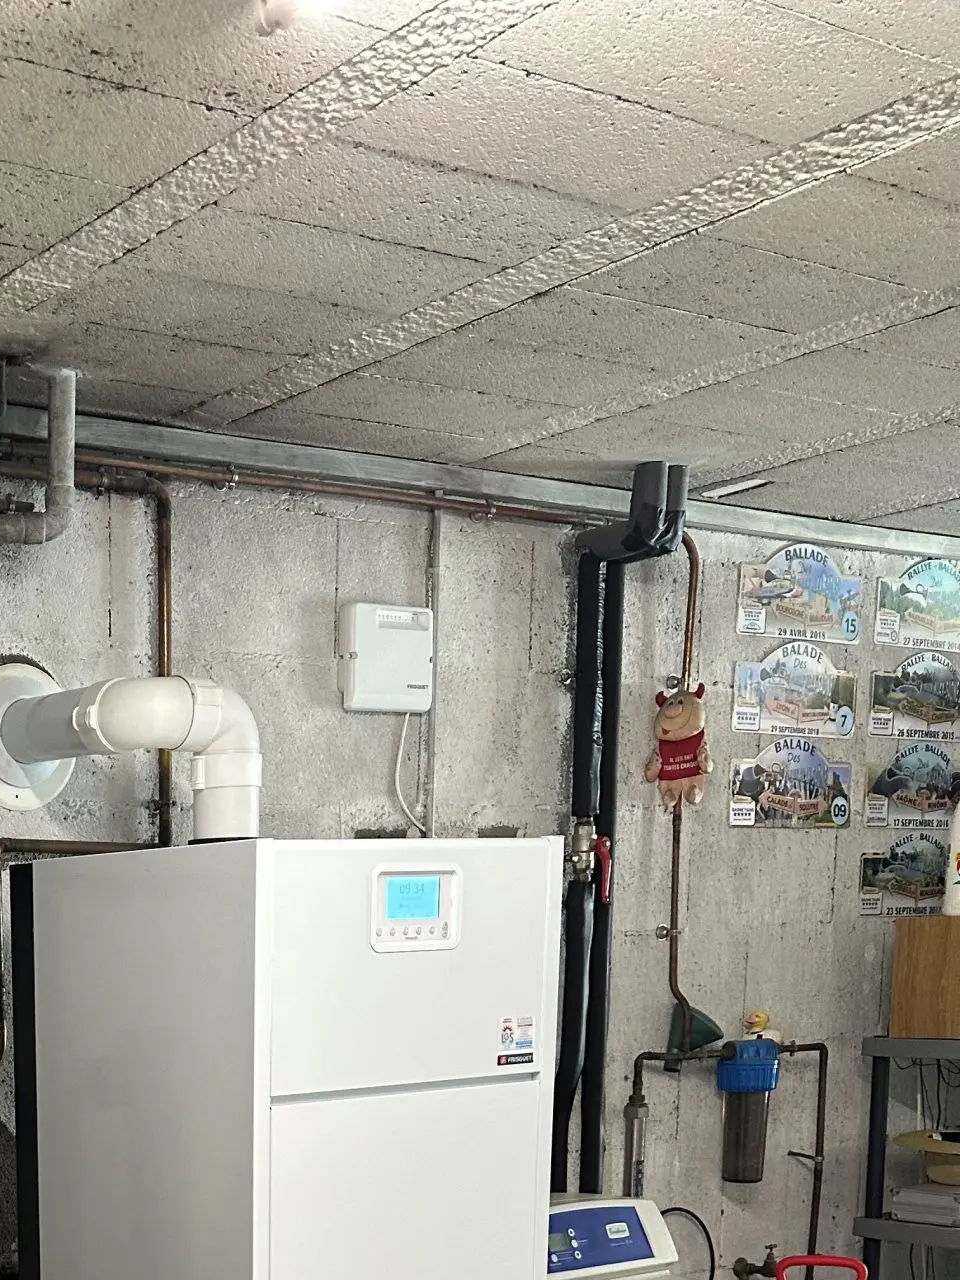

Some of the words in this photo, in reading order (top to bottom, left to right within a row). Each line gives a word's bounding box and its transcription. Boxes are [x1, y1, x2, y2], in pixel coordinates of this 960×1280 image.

[785, 548, 829, 566] BALLADE
[907, 562, 932, 580] RALLYE
[845, 618, 856, 633] 15
[778, 628, 787, 636] 29
[790, 628, 807, 638] AVRIL
[903, 637, 911, 645] 27
[912, 638, 946, 649] SEPTEMBRE
[782, 644, 824, 664] BALADE
[901, 654, 925, 673] RALLYE
[841, 714, 847, 727] 7
[779, 726, 806, 734] SEPTEMBRE
[906, 729, 939, 739] SEPTEMBRE
[774, 739, 816, 757] BALADE
[895, 745, 919, 764] RALLYE
[925, 744, 951, 767] BALLADE
[833, 804, 846, 817] 09
[893, 818, 900, 827] 17
[901, 818, 934, 827] SEPTEMBRE
[890, 834, 914, 851] RALLYE
[886, 907, 893, 915] 23
[895, 906, 927, 915] SEPTEMBRE
